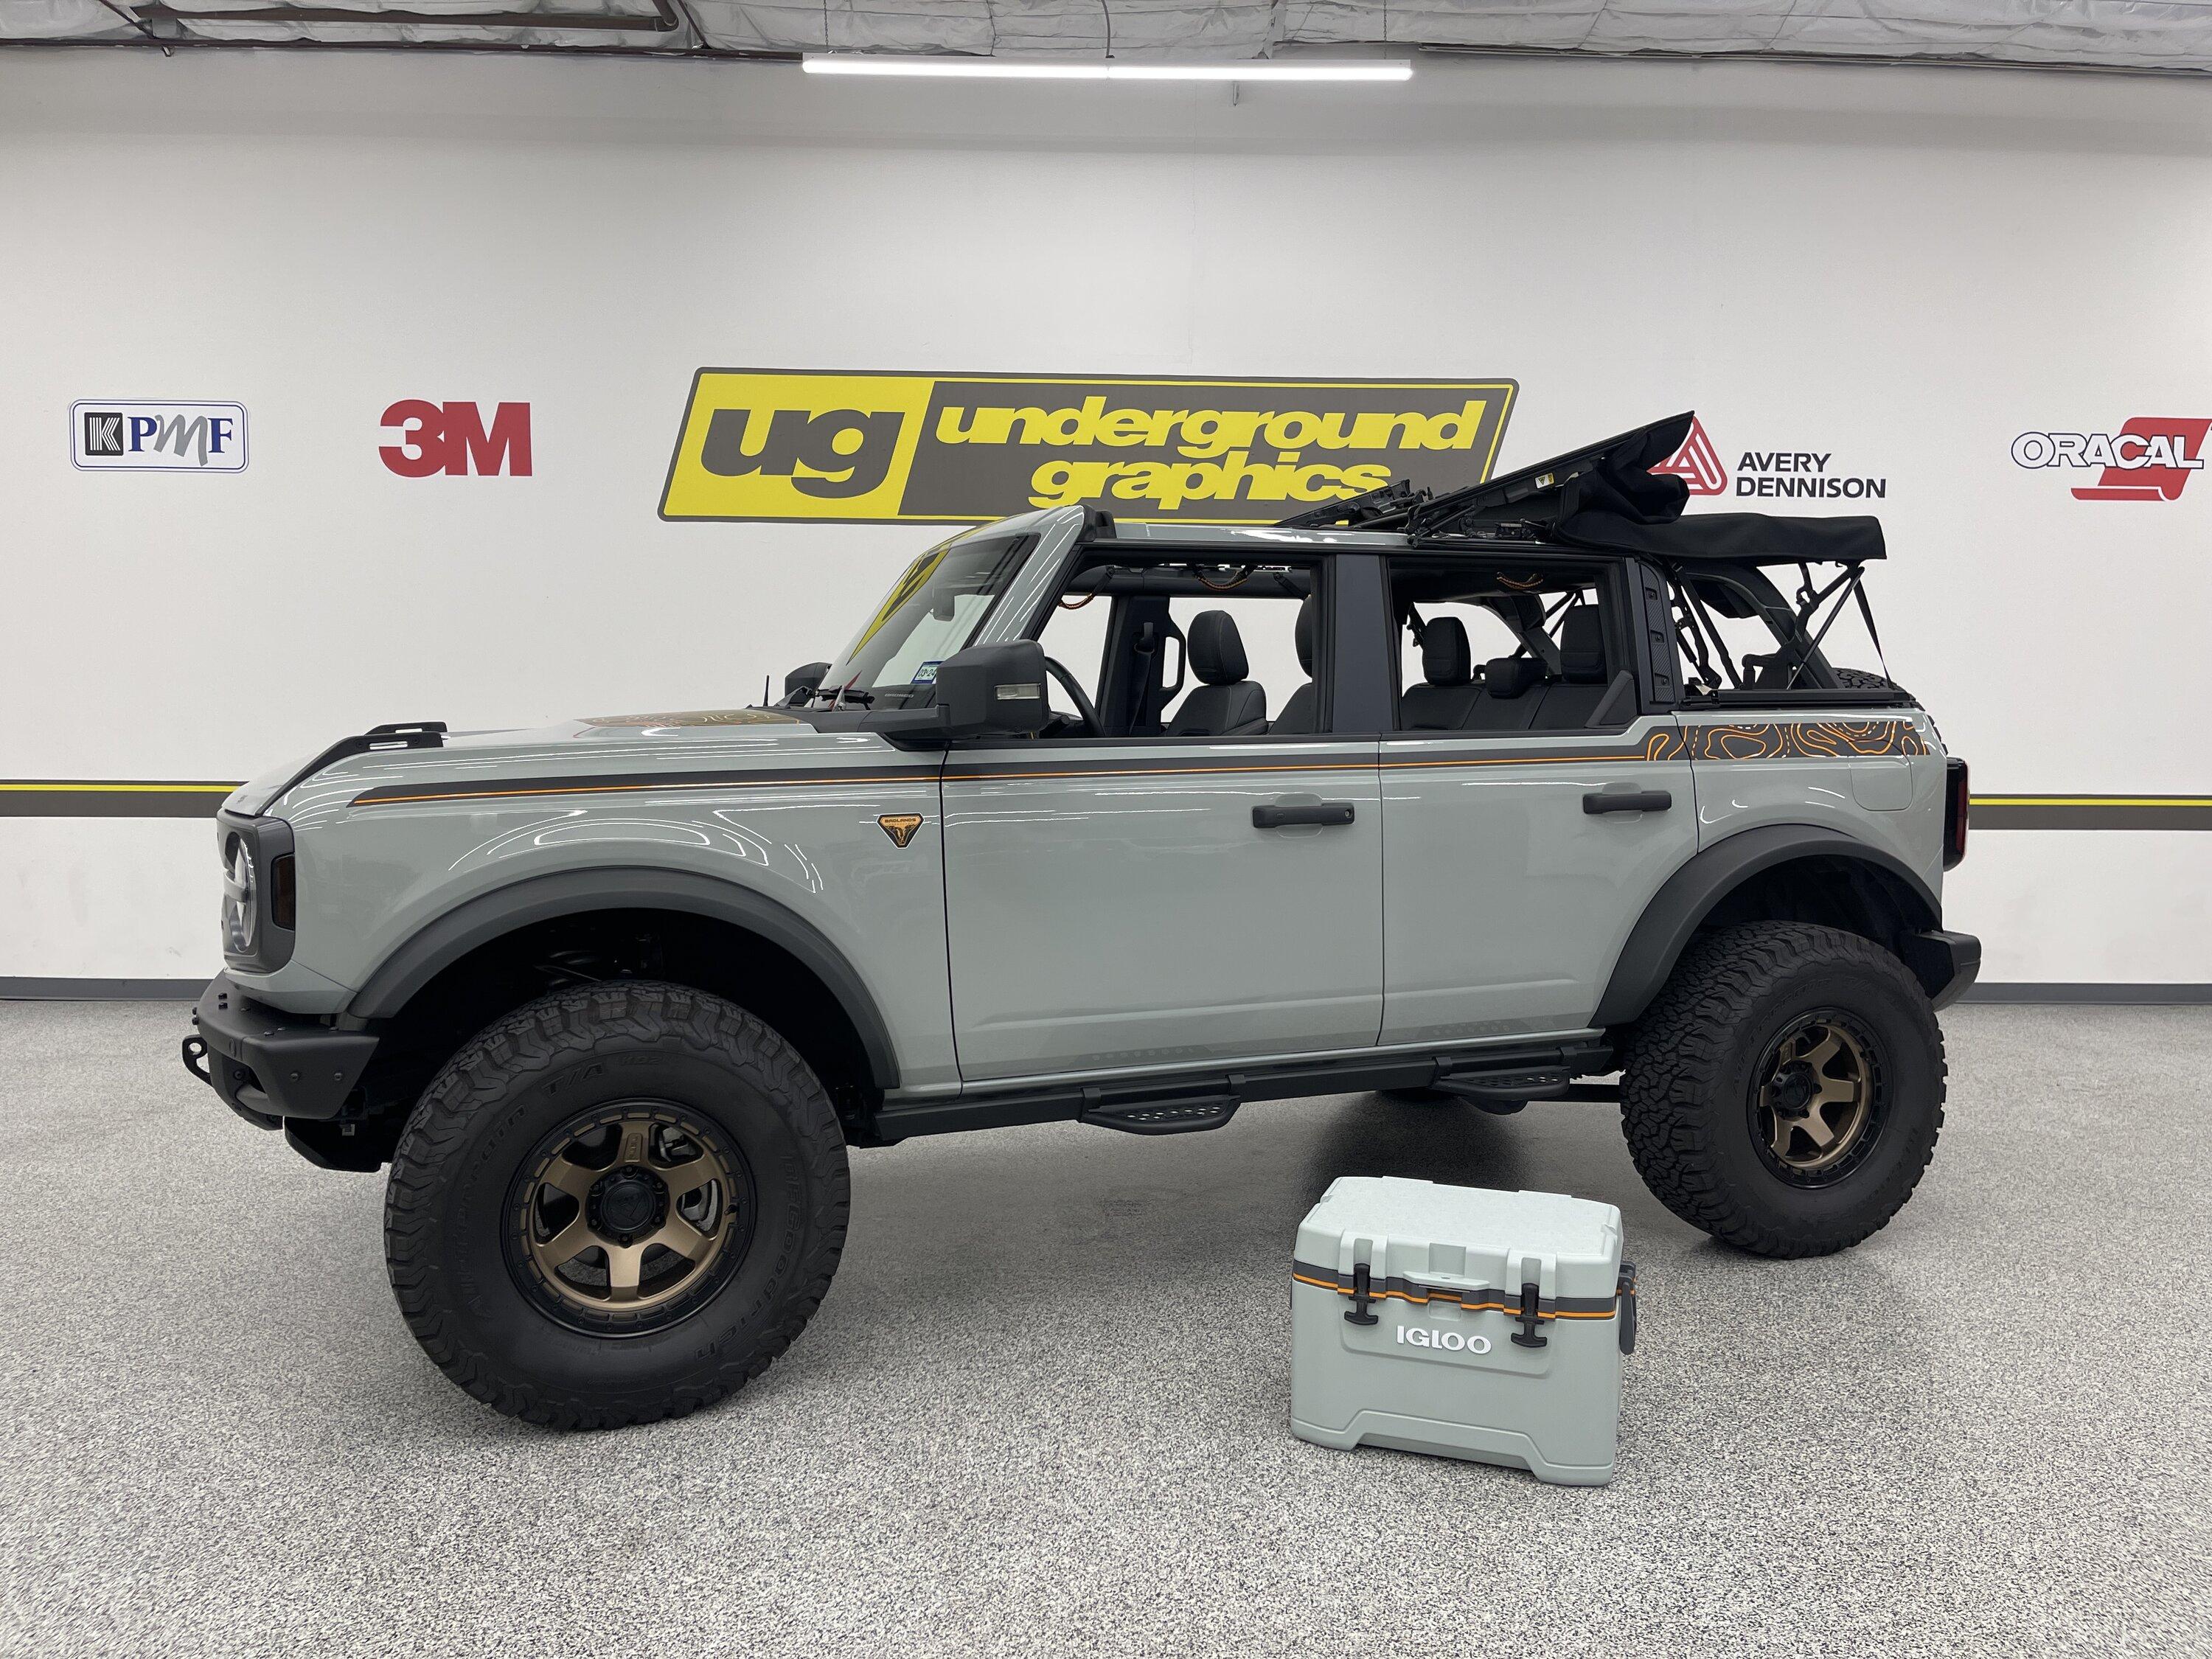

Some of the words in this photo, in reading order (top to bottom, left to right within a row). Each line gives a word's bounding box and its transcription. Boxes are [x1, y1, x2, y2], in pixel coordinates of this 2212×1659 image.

[88, 414, 234, 467] KPMF
[379, 399, 533, 478] 3M
[936, 396, 1487, 458] underground
[2011, 431, 2204, 470] ORACAL
[701, 409, 905, 499] ug
[1737, 452, 1832, 473] AVERY
[1029, 451, 1392, 511] graphics
[1736, 476, 1886, 498] DENNISON
[1397, 1325, 1492, 1354] IGLOO
